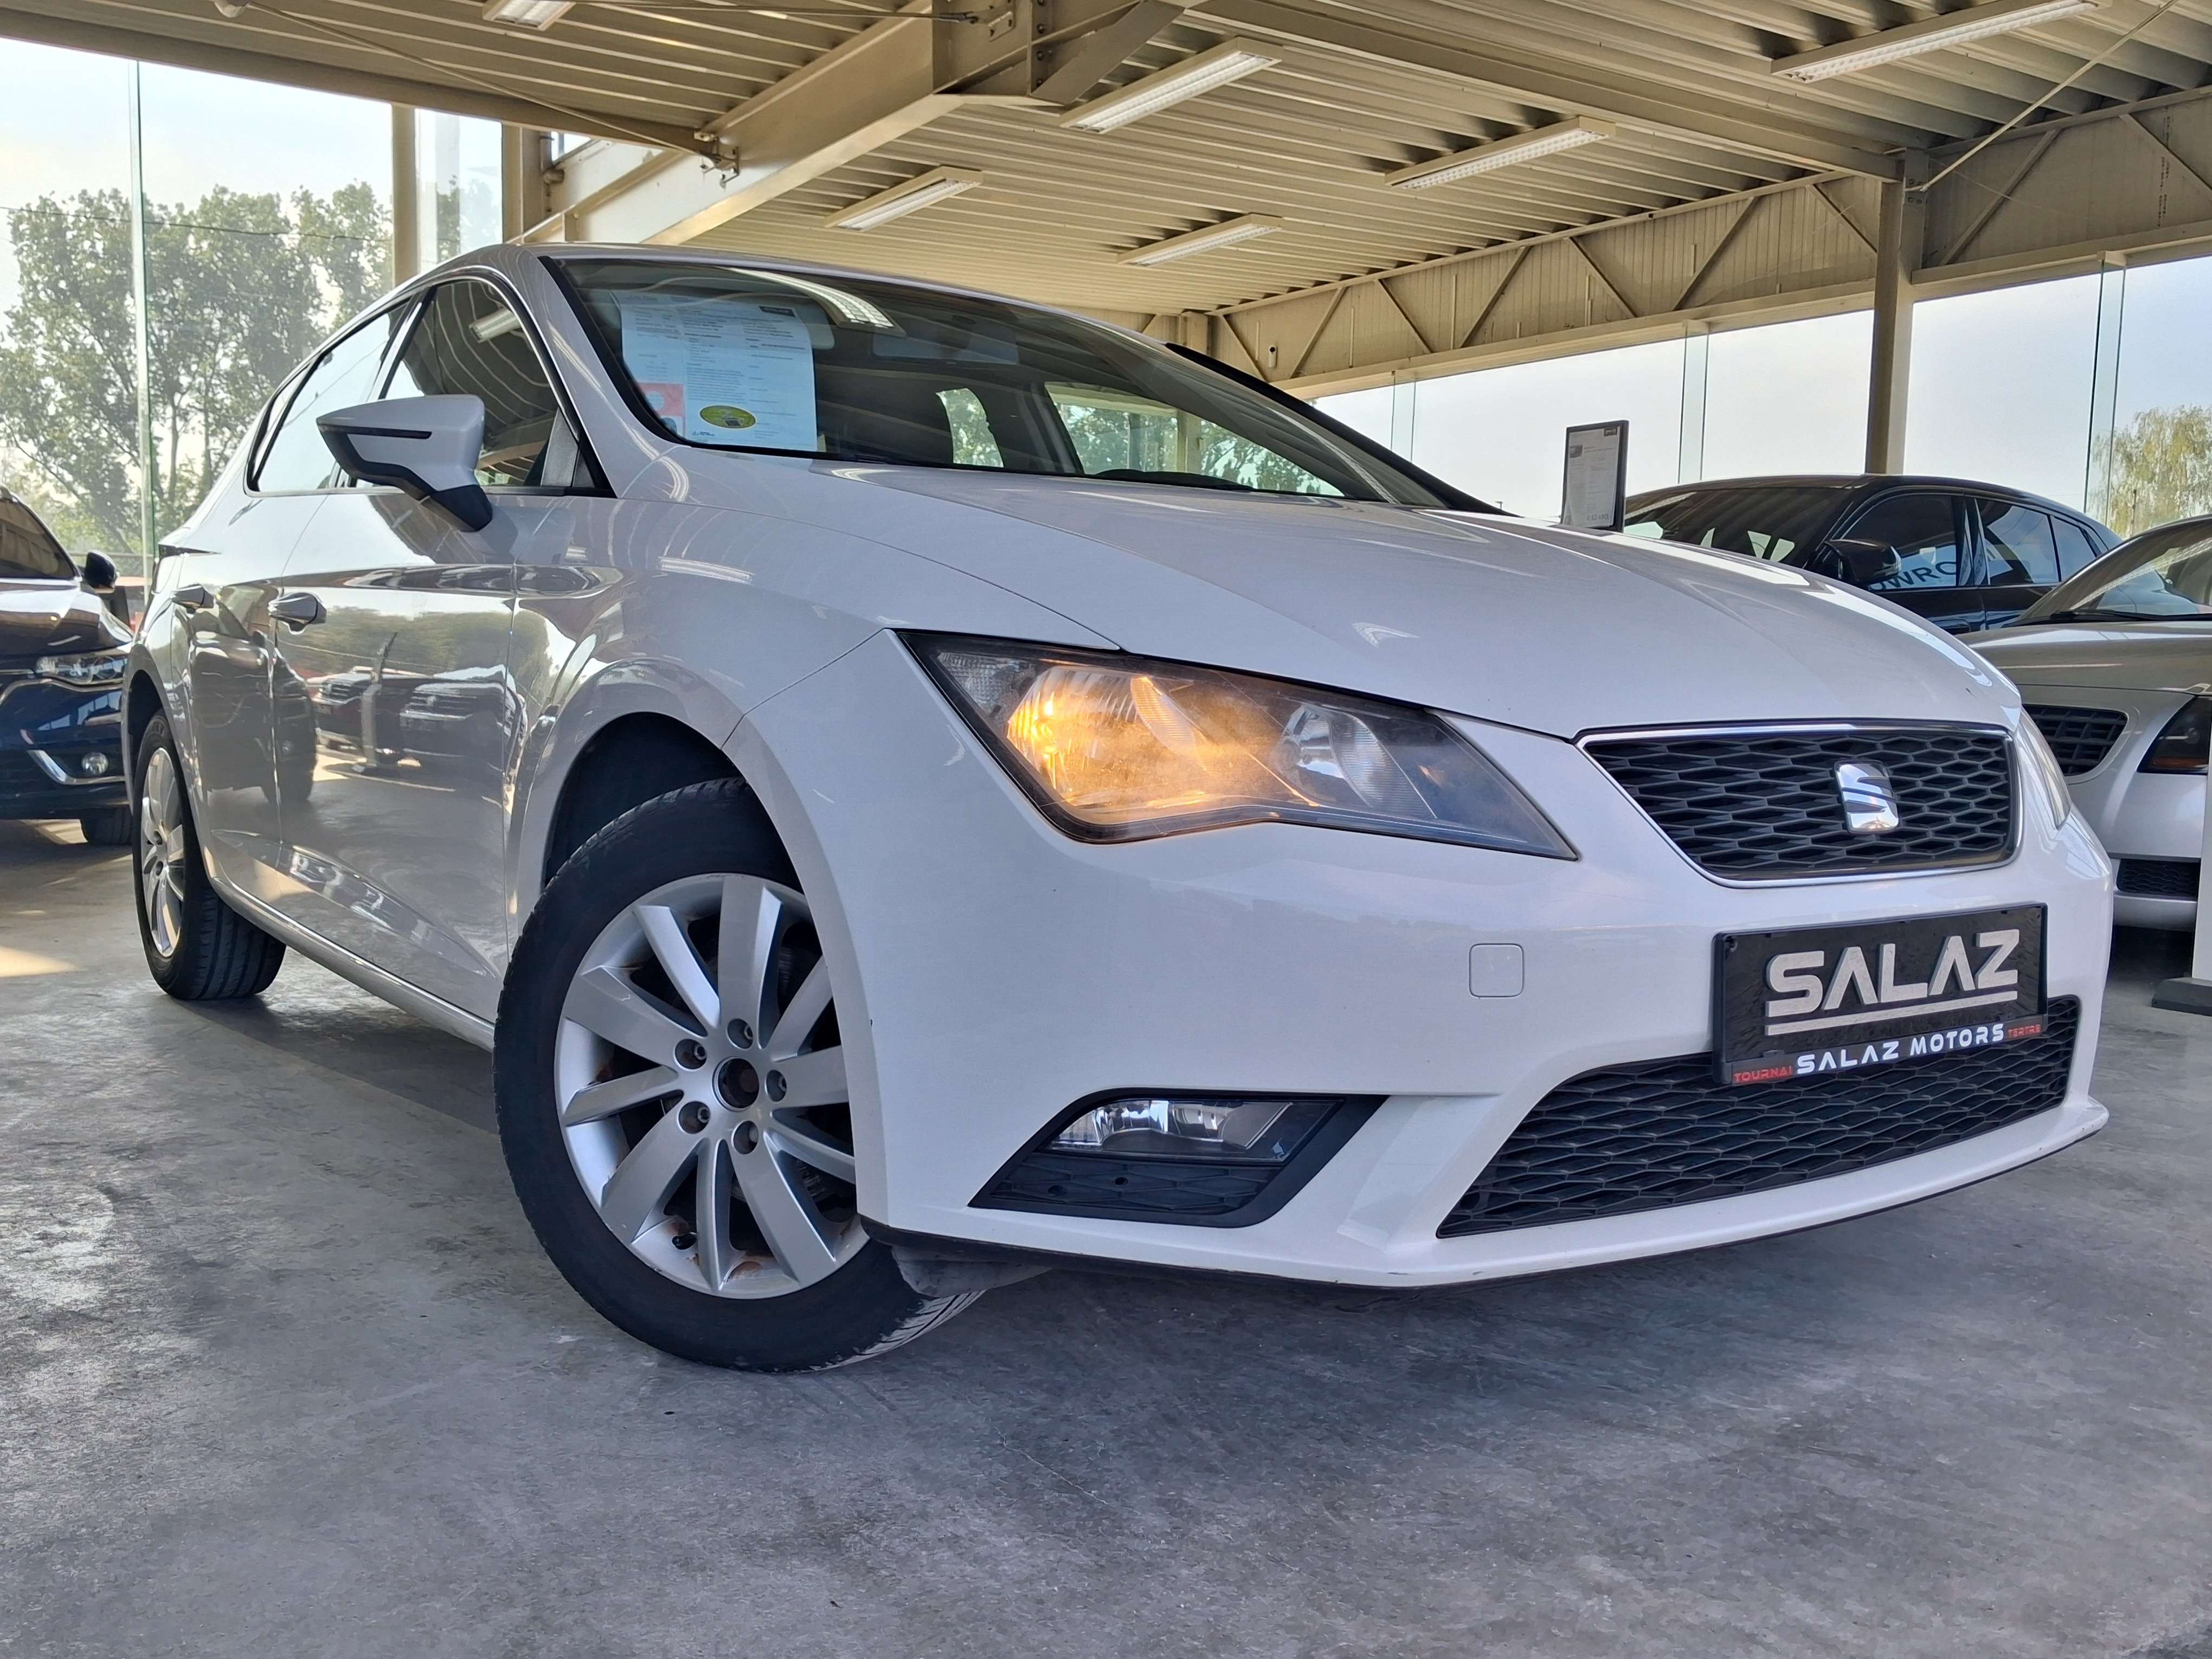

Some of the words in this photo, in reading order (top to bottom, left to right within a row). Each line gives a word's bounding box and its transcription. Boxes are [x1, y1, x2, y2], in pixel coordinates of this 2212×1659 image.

[1765, 928, 2020, 1018] SALAZ
[1734, 1065, 1792, 1083] TOURNAI
[1797, 1041, 1899, 1075] SALAZ
[1909, 1023, 2004, 1056] MOTORS
